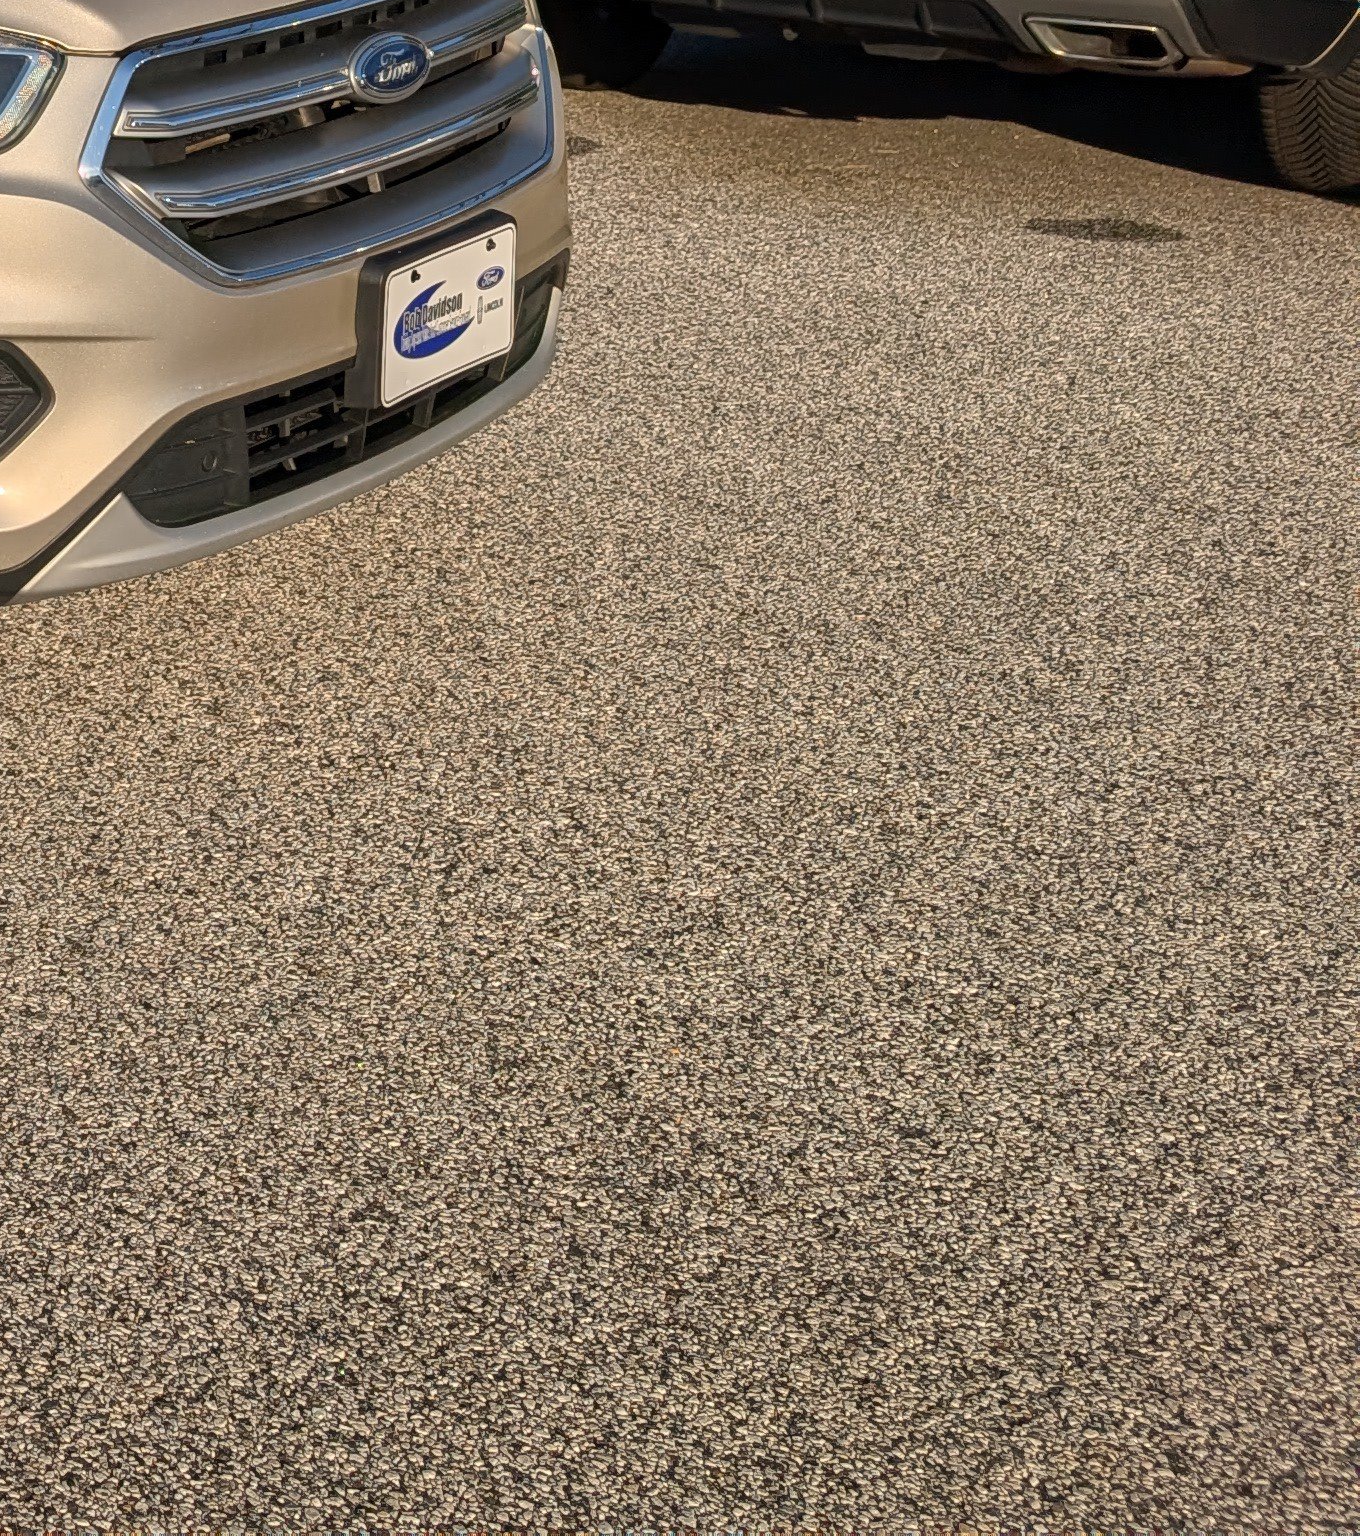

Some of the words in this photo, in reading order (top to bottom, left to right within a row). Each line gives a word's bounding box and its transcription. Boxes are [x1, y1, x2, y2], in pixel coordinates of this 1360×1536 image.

[374, 48, 419, 84] Ford
[402, 307, 422, 335] Bob
[422, 292, 463, 326] Davidson
[484, 298, 504, 314] LINCOLN
